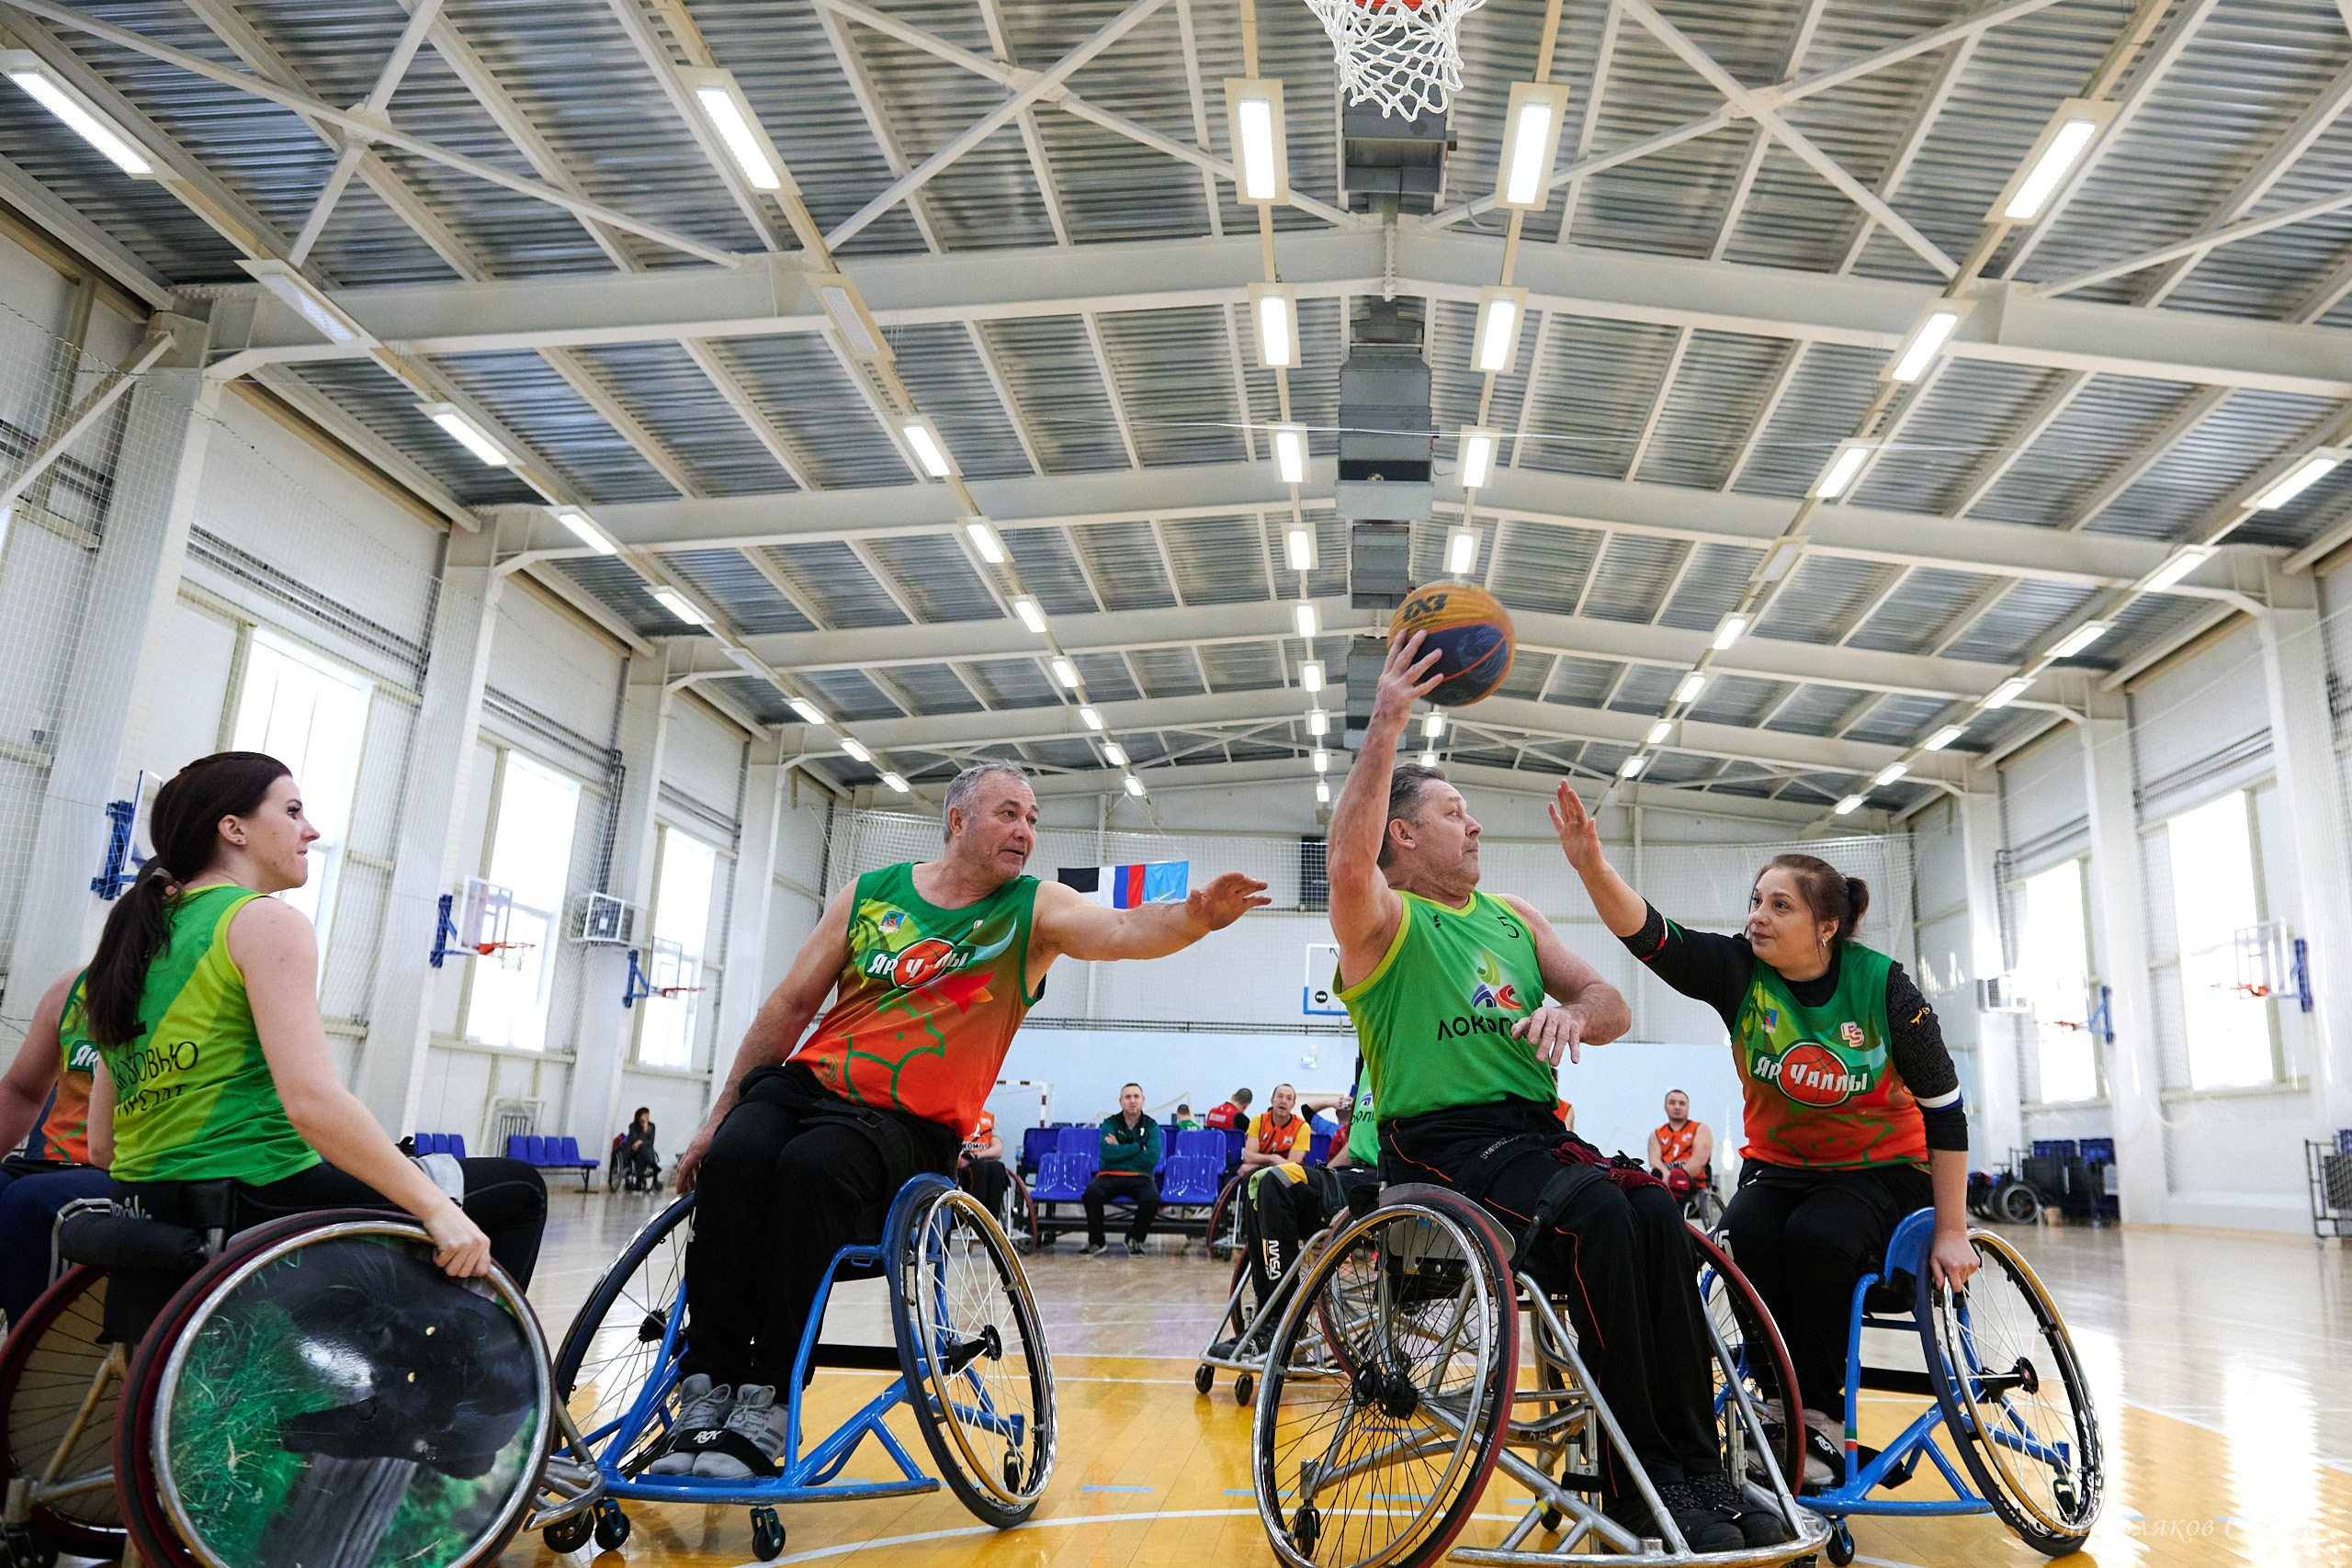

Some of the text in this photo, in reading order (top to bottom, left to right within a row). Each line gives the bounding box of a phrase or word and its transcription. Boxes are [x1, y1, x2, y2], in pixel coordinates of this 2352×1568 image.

[1754, 1055, 1868, 1092] ЯР ЧАЛЛЫ
[1268, 1239, 1282, 1280] NASA
